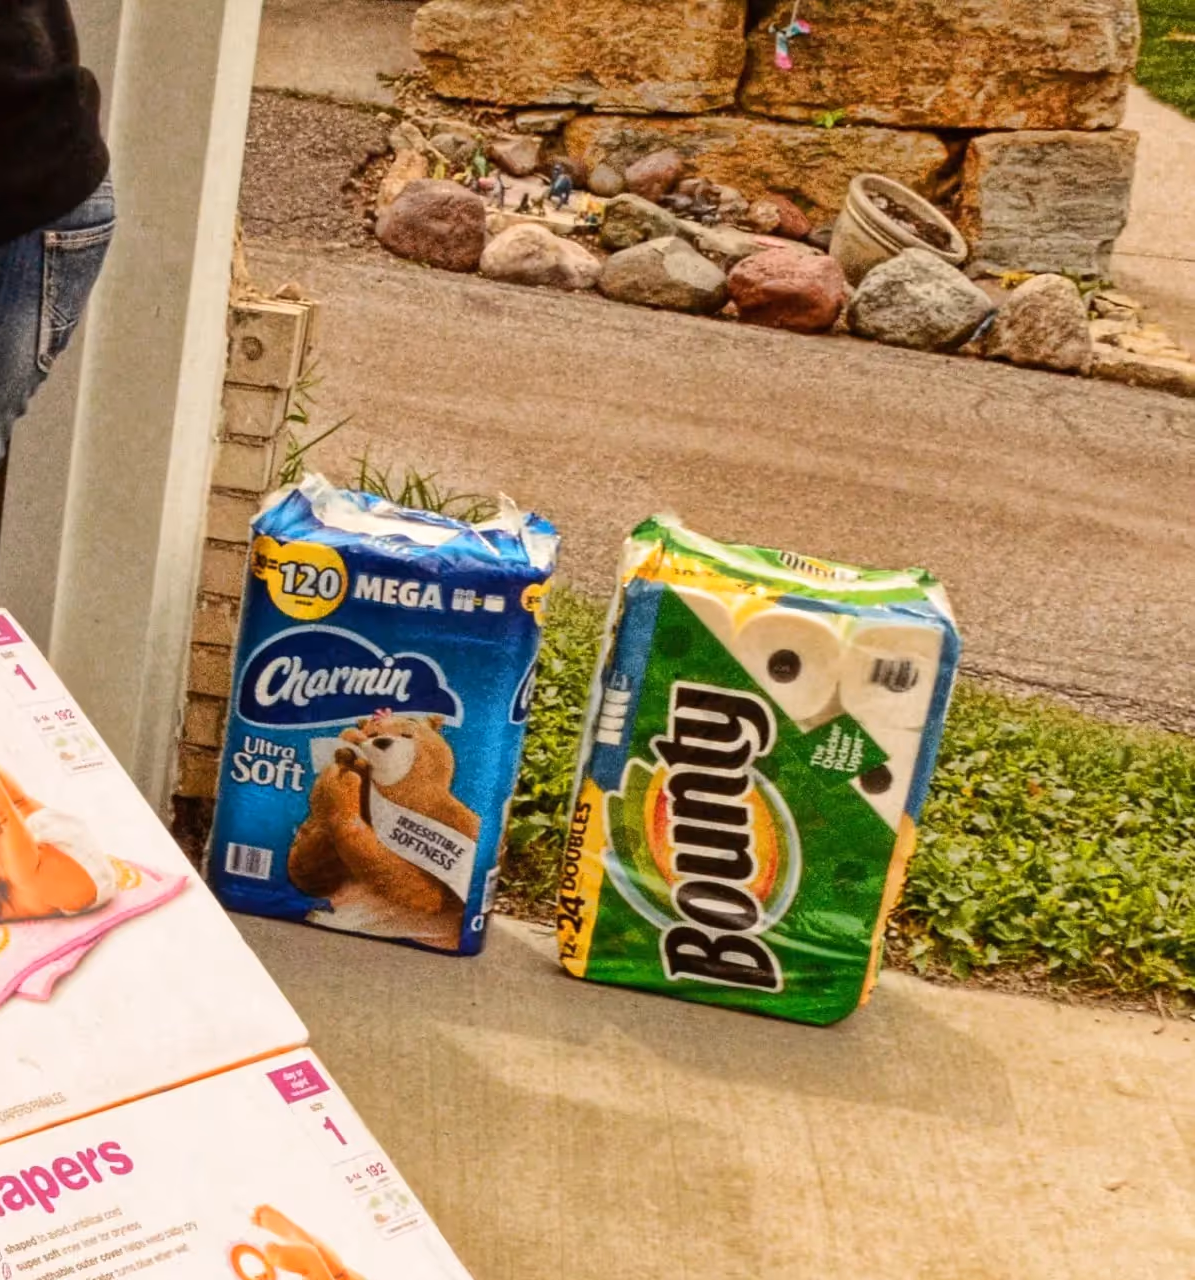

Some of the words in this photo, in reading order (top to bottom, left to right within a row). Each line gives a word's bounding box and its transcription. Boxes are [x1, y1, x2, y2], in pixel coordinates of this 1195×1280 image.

[279, 561, 342, 599] 120
[354, 573, 443, 611] MEGA
[13, 663, 37, 690] 1
[255, 656, 412, 707] Charmin
[243, 735, 296, 760] Ultra
[822, 723, 842, 769] Quicker
[834, 733, 852, 771] Picker
[230, 752, 305, 792] Soft
[389, 828, 456, 872] SOFTNESS
[396, 815, 466, 858] IRRESISTIBLE
[561, 802, 591, 891] DOUBLES
[654, 685, 778, 990] Bounty
[322, 1116, 347, 1145] 1
[365, 1161, 387, 1177] 192
